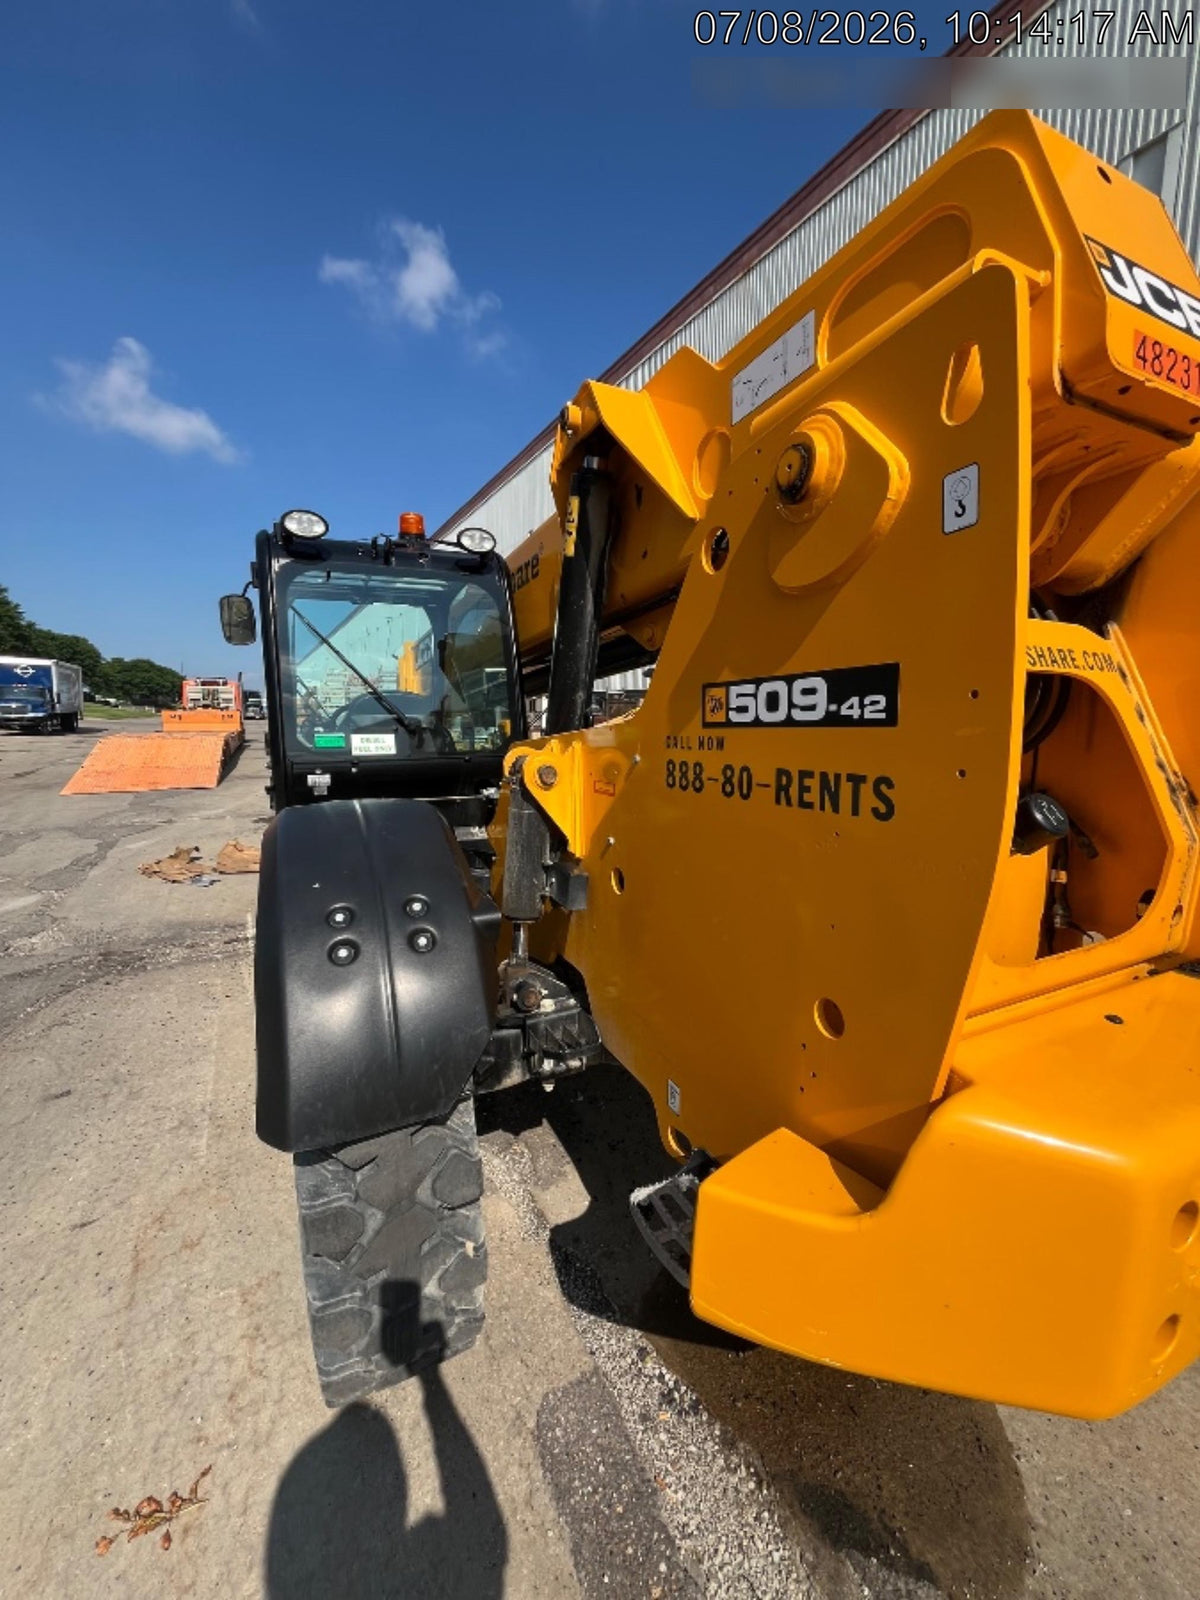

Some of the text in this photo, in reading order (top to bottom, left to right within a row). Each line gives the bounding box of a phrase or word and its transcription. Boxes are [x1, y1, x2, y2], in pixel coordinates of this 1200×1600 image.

[728, 677, 887, 723] 509-42
[665, 735, 725, 751] CALL NOW
[665, 758, 896, 822] 888-80-RENTS
